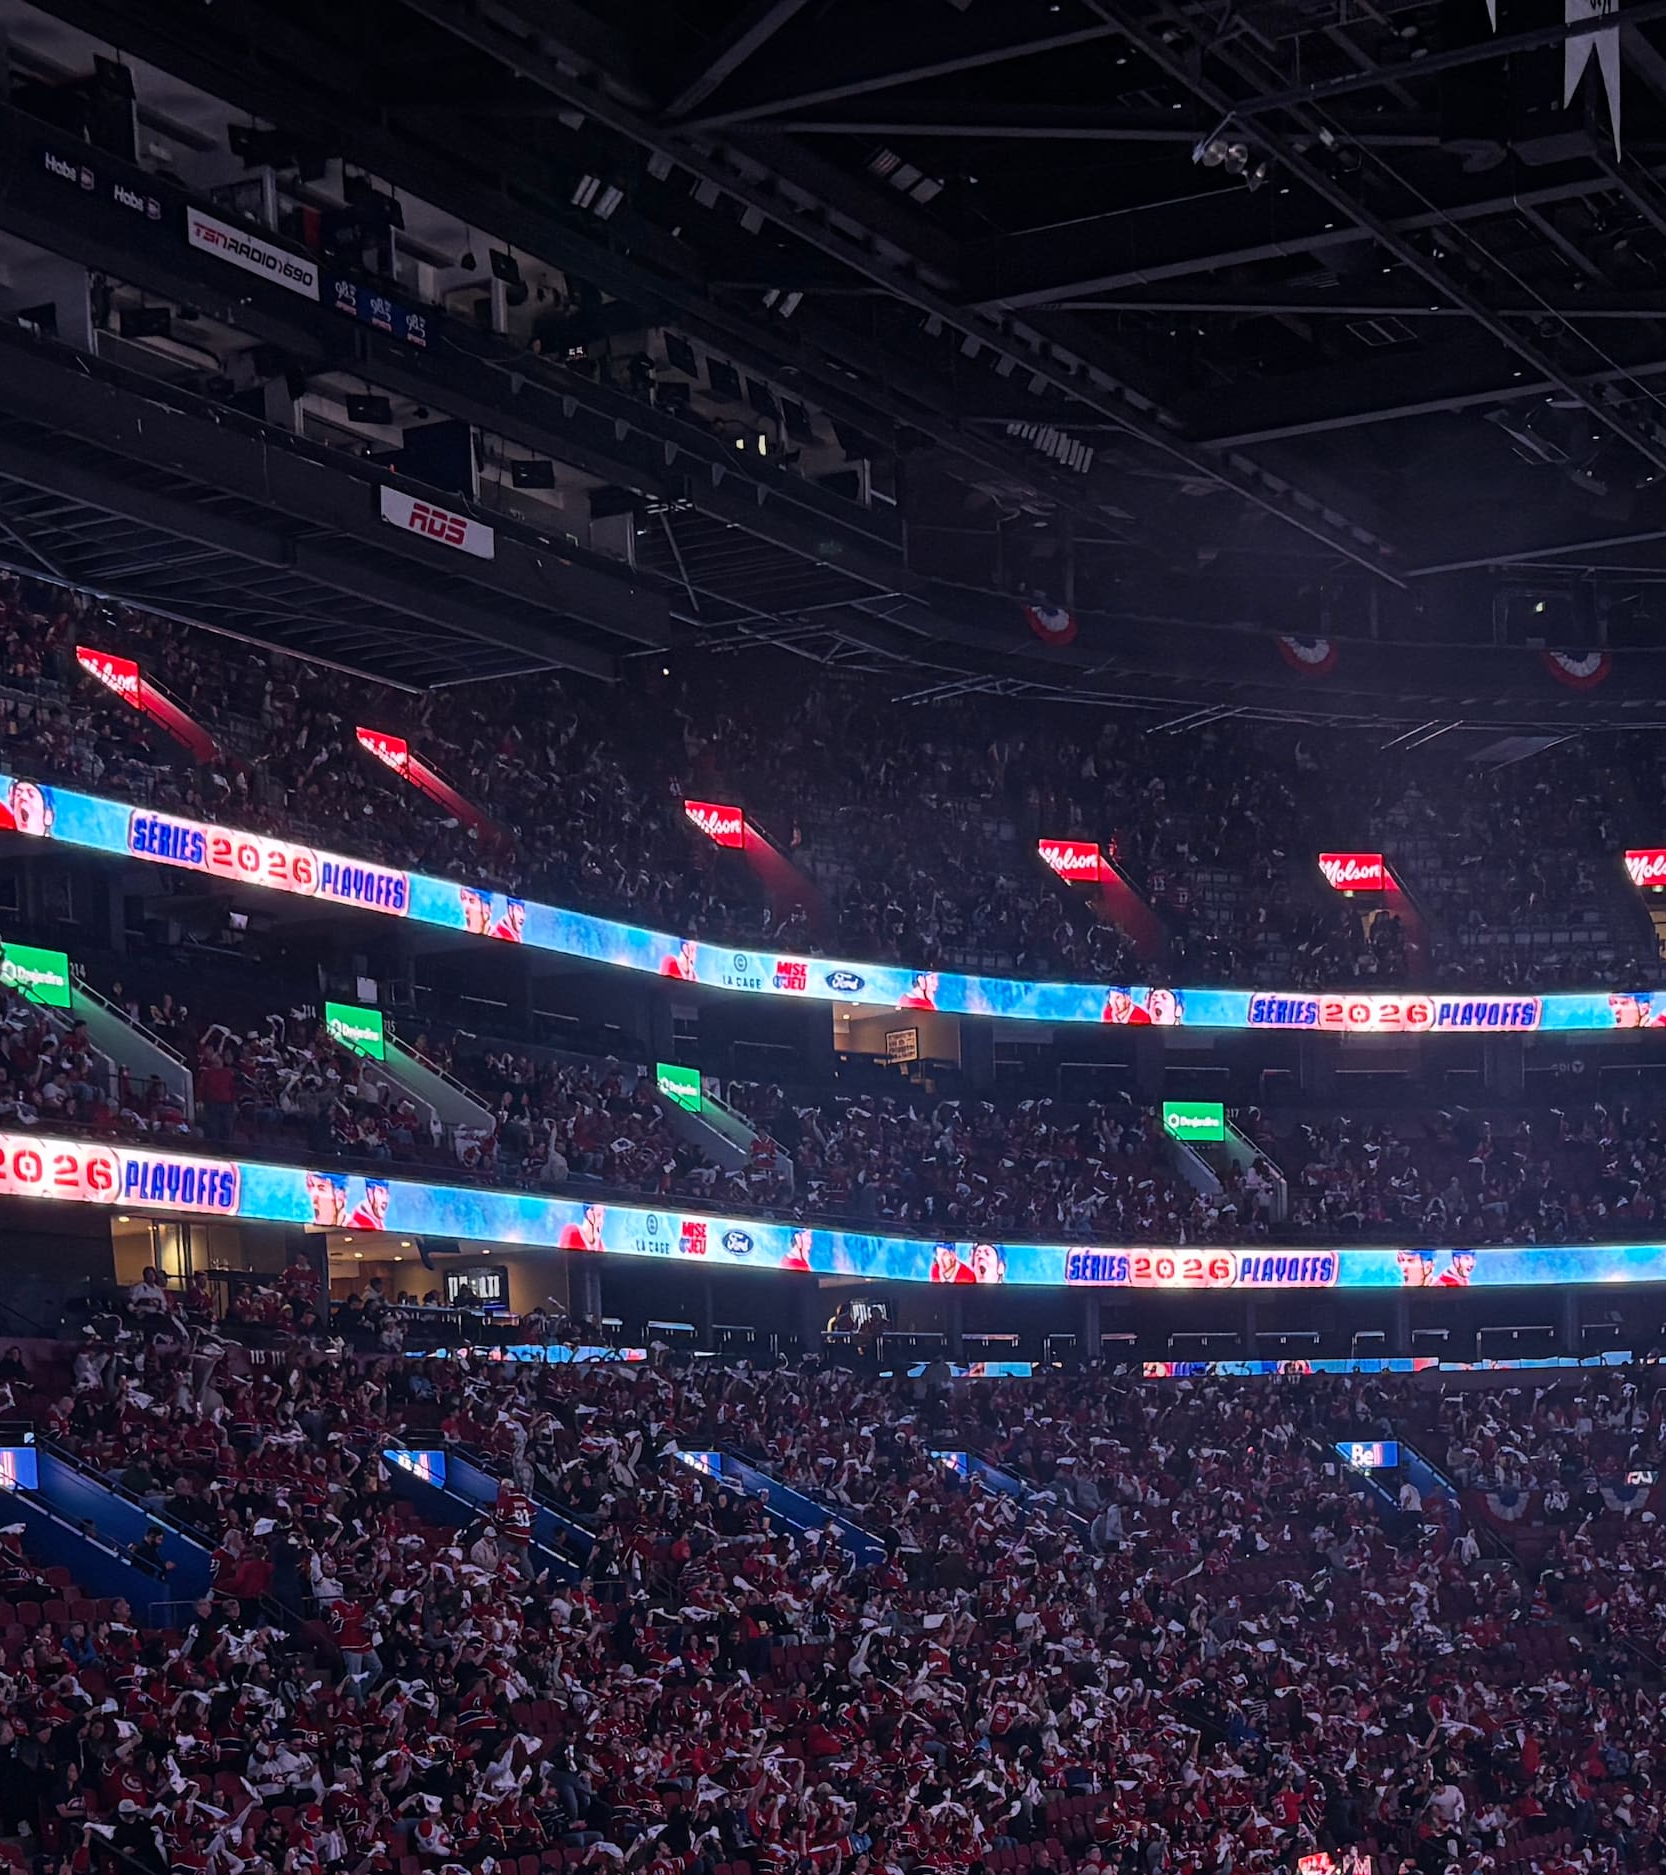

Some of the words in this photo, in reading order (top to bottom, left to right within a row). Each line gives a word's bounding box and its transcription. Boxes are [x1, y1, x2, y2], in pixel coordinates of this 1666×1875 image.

[132, 813, 204, 863] SÉRIES
[211, 835, 312, 885] 2026
[320, 861, 406, 911] PLAYOFFS
[1318, 859, 1381, 884] Molson
[776, 960, 807, 977] MISE
[1252, 996, 1317, 1024] SÉRIES
[1324, 1003, 1429, 1024] 2026
[1439, 1000, 1534, 1026] PLAYOFFS
[1180, 1116, 1220, 1128] Desjardins
[124, 1160, 234, 1209] PLAYOFFS
[1069, 1250, 1127, 1282] SÉRIES
[1134, 1257, 1230, 1279] 2026
[1240, 1252, 1333, 1282] PLAYOFFS
[1351, 1444, 1383, 1468] Bell
